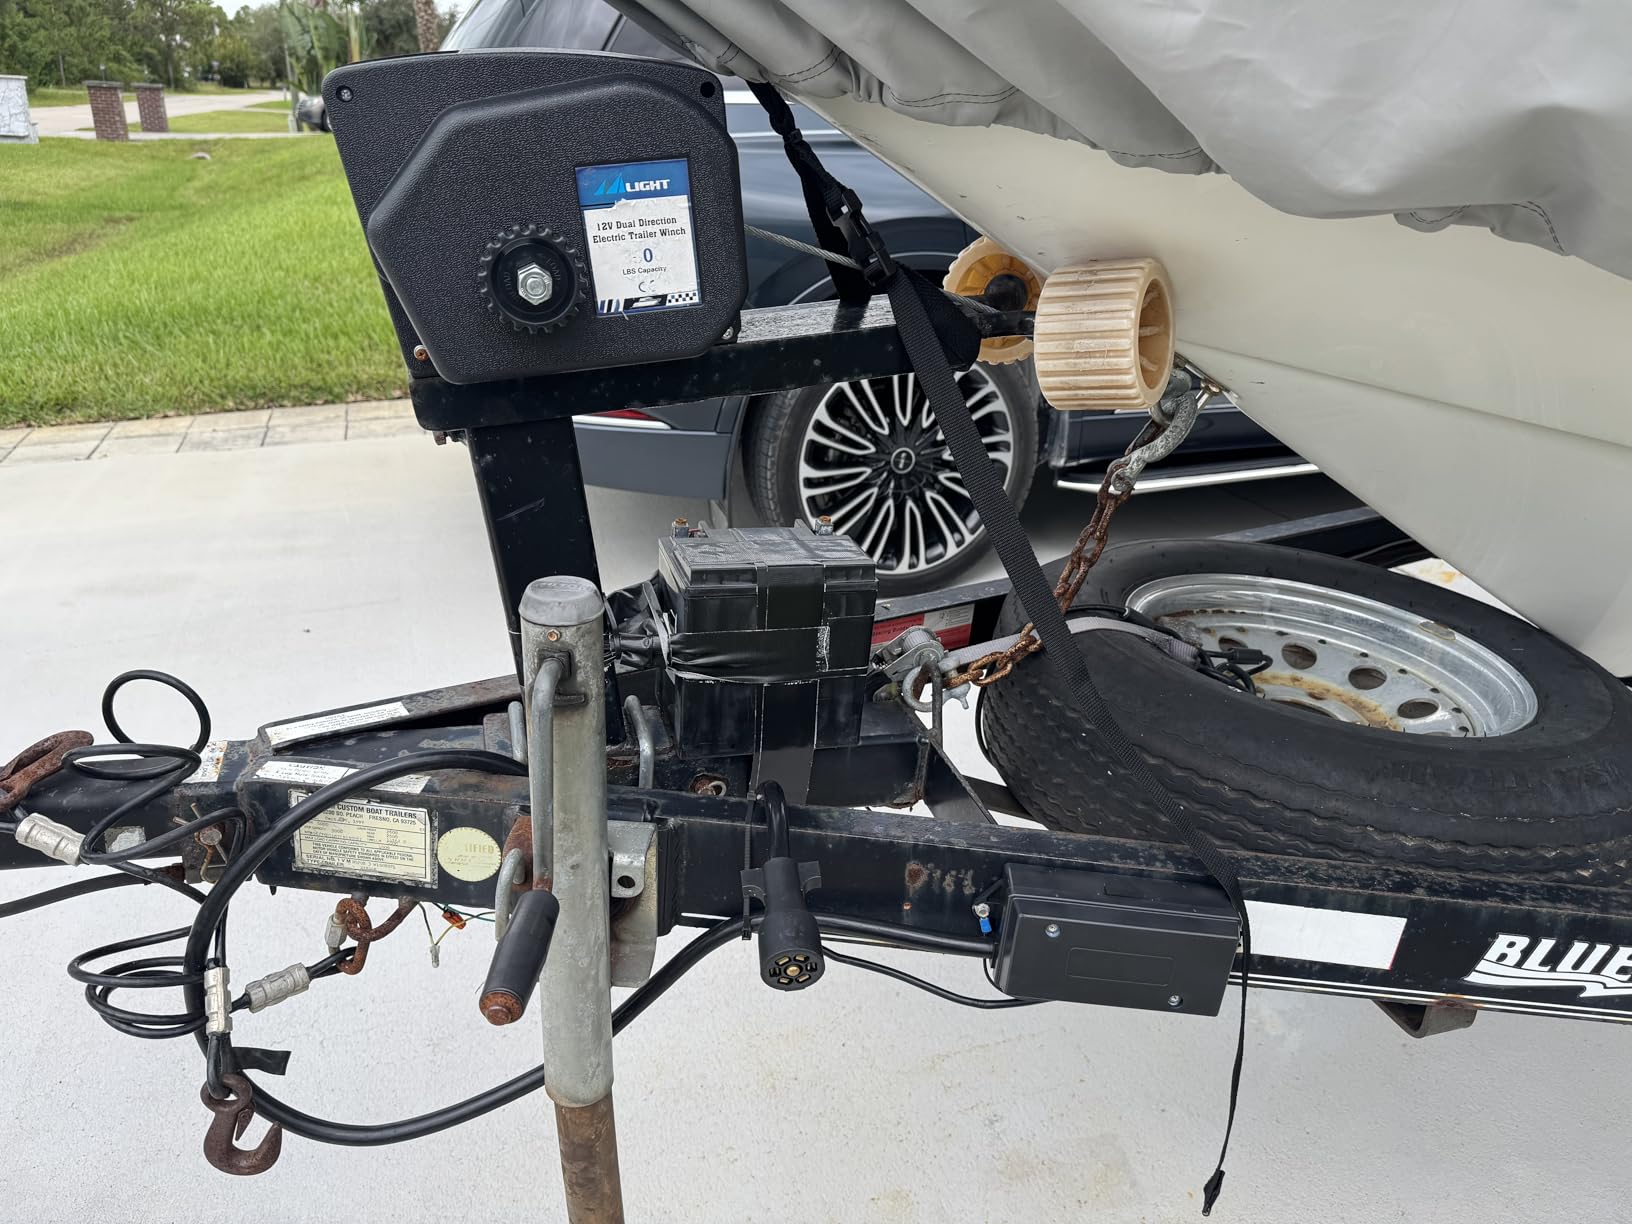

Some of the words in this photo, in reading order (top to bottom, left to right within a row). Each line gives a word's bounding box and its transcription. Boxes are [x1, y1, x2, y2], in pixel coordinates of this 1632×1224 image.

[625, 179, 671, 192] LIGHT
[597, 220, 613, 231] 12V
[616, 219, 636, 230] Dual
[638, 216, 677, 227] Direction
[593, 233, 626, 244] Electric
[628, 230, 657, 240] Trailer
[659, 227, 686, 237] Winch
[622, 267, 636, 275] LBS
[638, 265, 667, 274] Capacity
[337, 803, 365, 813] CUSTOM
[366, 807, 383, 815] BOAT
[384, 809, 417, 819] TRAILERS
[369, 815, 392, 823] FRESNO,
[1482, 933, 1632, 982] BLUE
